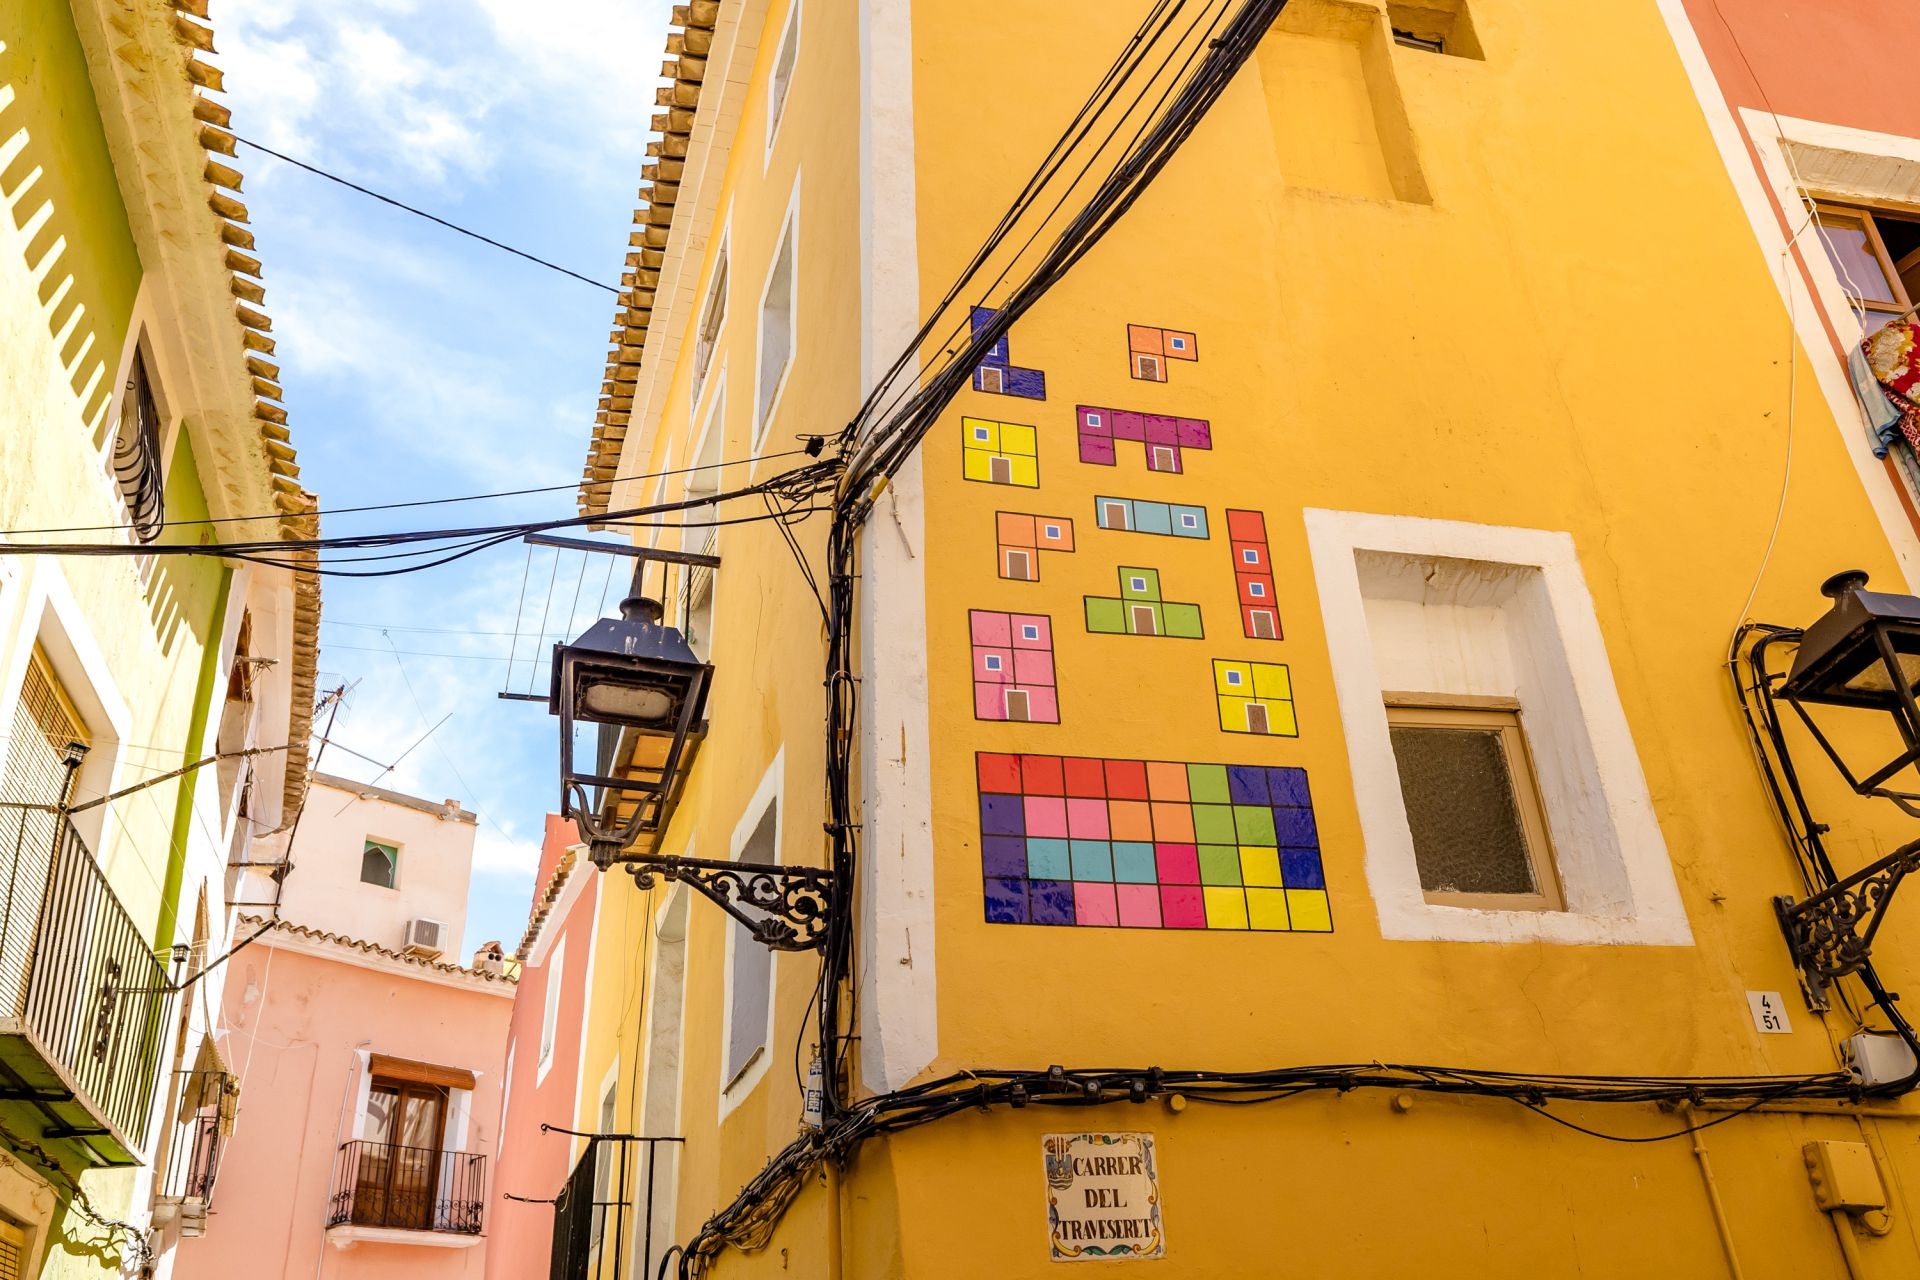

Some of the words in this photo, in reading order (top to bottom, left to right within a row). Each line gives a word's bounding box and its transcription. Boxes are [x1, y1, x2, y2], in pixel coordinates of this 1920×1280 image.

[1763, 1015, 1780, 1030] 51
[1073, 1156, 1141, 1176] CARRER
[1084, 1188, 1127, 1208] DEL
[1059, 1218, 1151, 1240] TRAVESERET
